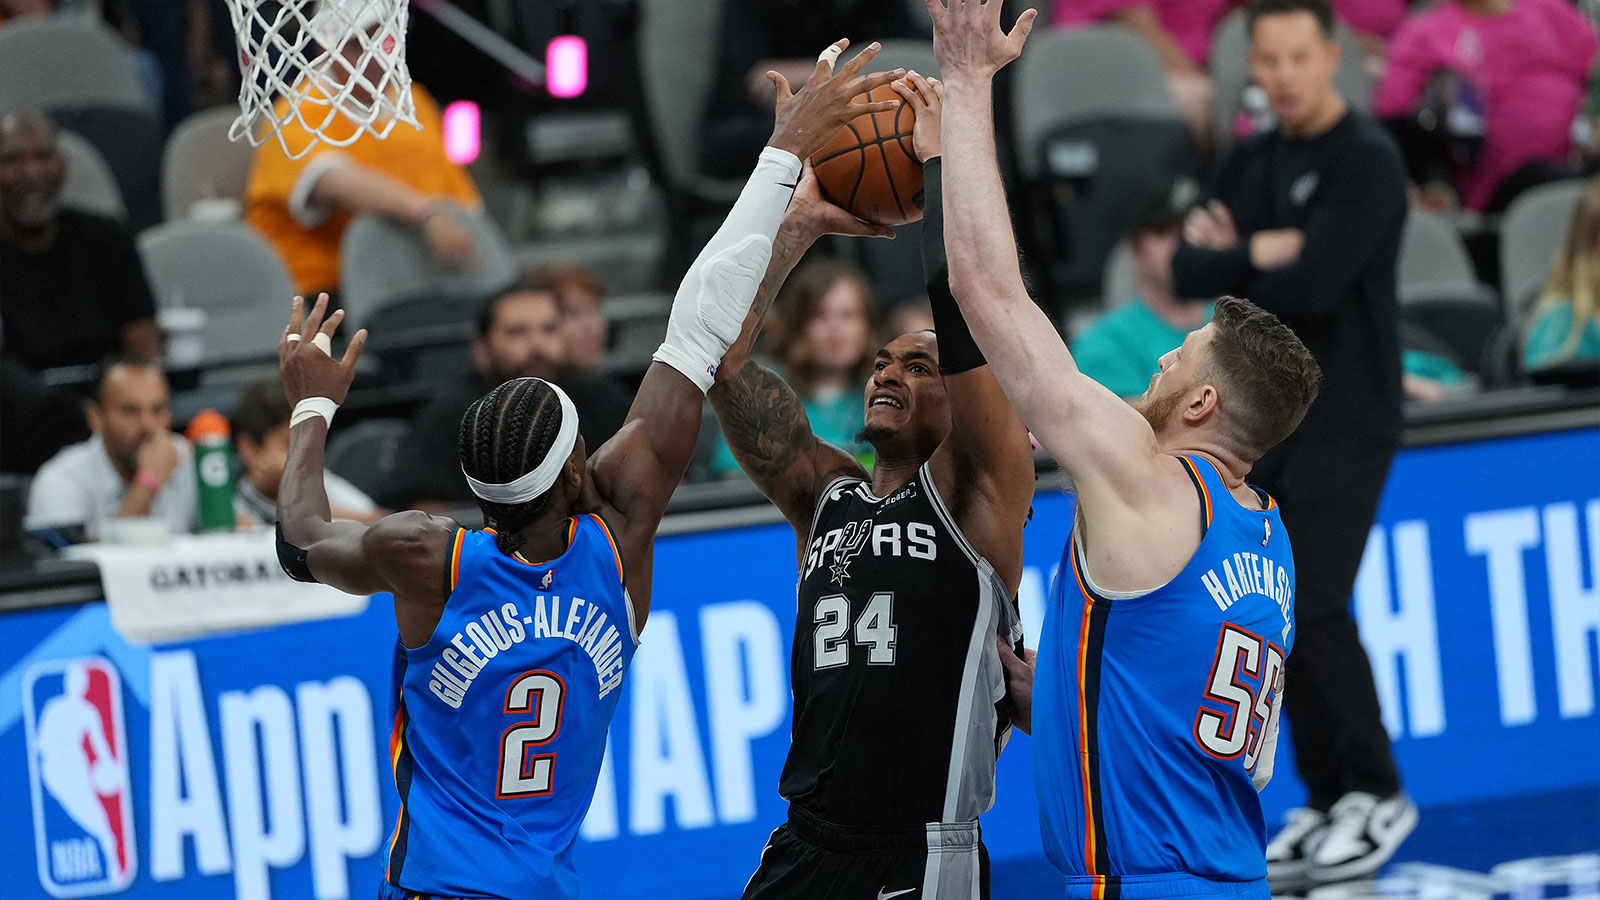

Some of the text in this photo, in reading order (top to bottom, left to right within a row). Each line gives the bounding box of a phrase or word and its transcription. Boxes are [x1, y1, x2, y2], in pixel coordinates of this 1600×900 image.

[151, 561, 286, 593] GATORA
[804, 519, 938, 585] SPURS
[428, 595, 623, 710] GILGEOUS-ALEXANDER
[813, 591, 899, 671] 24
[495, 669, 567, 800] 2
[1193, 621, 1286, 775] 55
[150, 648, 383, 900] App
